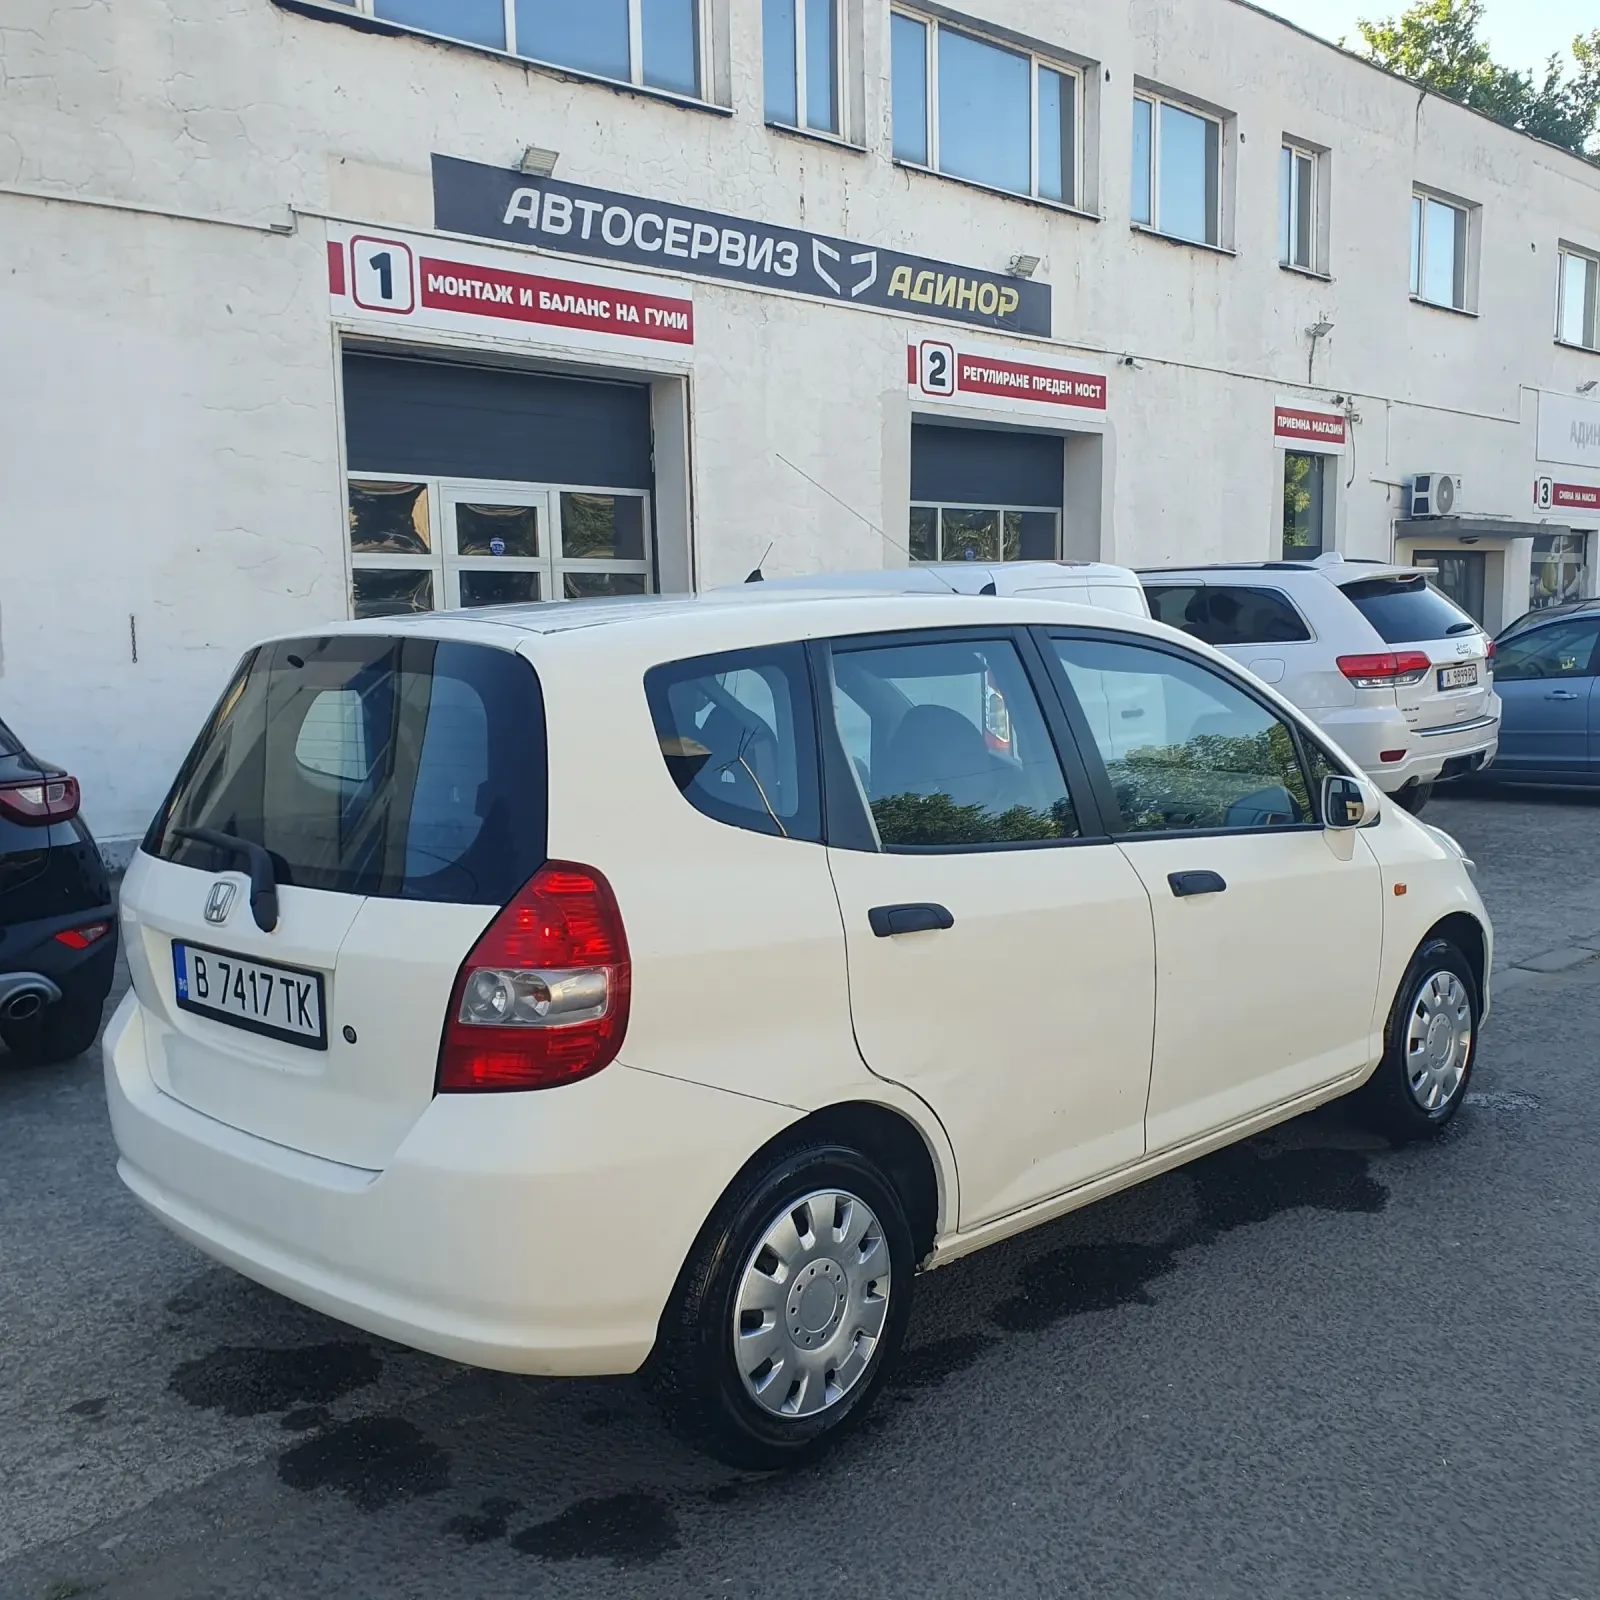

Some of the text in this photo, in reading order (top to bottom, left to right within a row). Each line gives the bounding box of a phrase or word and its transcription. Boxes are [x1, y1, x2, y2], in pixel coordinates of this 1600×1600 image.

[502, 186, 1019, 317] АВТОСЕРВИЗ АДИНОР
[369, 252, 688, 331] 1 МОНТАЖ И БАЛАНС НА ГУМИ
[929, 350, 1102, 399] 2 РЕГУЛИРАНЕ ПРЕДЕН МОСТ
[1277, 415, 1343, 436] ПРИЕМНА МАГАЗИН
[1541, 482, 1549, 504] 3
[194, 955, 209, 999] B
